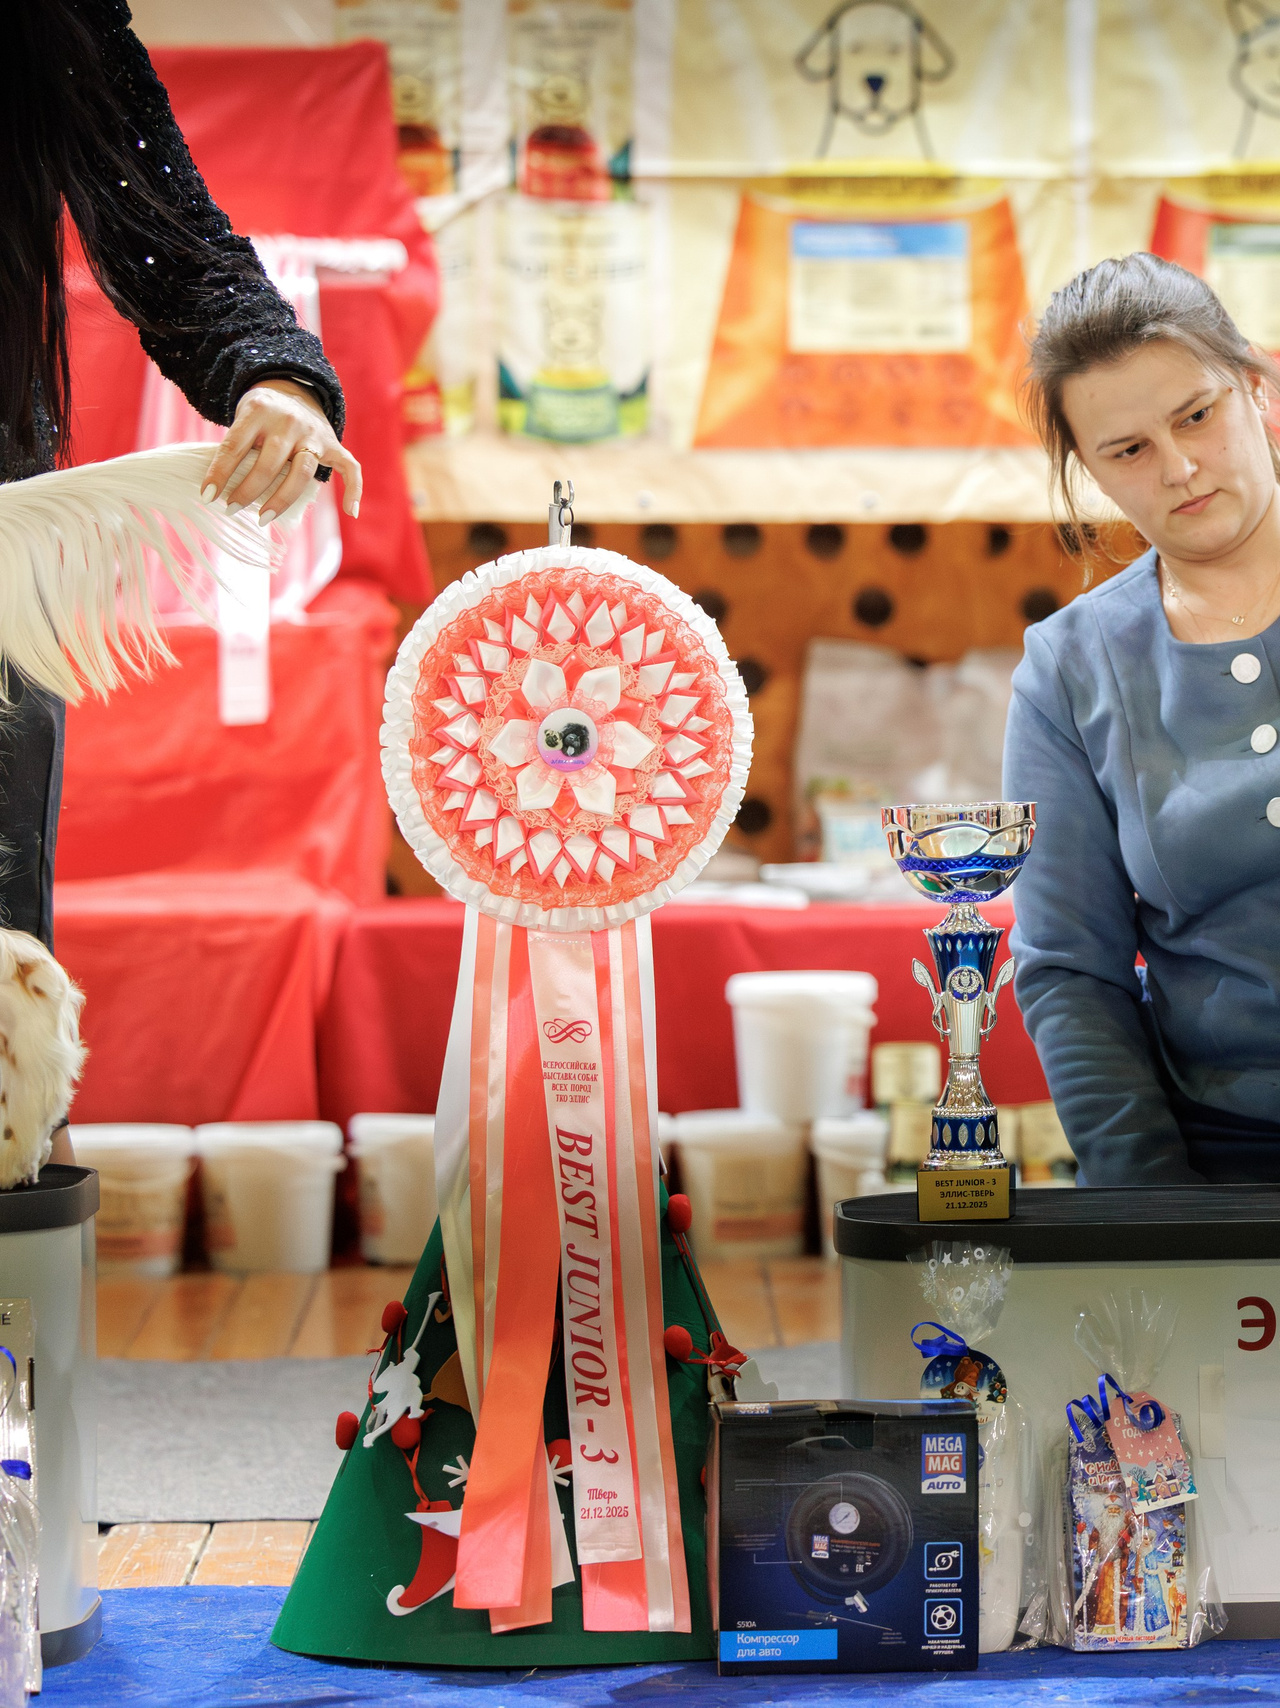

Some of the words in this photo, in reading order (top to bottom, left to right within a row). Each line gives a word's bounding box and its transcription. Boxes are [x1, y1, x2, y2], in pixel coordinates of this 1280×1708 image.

[542, 1060, 597, 1070] ВСЕРОССИЙСКАЯ
[543, 1071, 577, 1080] ВЫСТАВКА
[577, 1073, 599, 1081] СОБАК
[551, 1083, 568, 1091] ВСЕХ
[570, 1083, 592, 1093] ПОРОД
[555, 1094, 568, 1102] ТКО
[568, 1094, 591, 1103] ЭЛЛИС
[555, 1124, 600, 1240] BEST
[935, 1179, 954, 1187] BEST
[955, 1178, 985, 1187] JUNIOR
[991, 1178, 997, 1186] 3
[939, 1189, 995, 1198] ЭЛЛИС-ТВЕРЬ
[945, 1201, 988, 1210] 21.12.2025
[566, 1242, 611, 1408] JUNIOR
[925, 1436, 963, 1452] MEGA
[579, 1443, 620, 1465] 3
[928, 1455, 960, 1471] MAG
[926, 1480, 961, 1490] AUTO
[586, 1487, 618, 1505] Тверь
[580, 1505, 630, 1520] 21.12.2025
[736, 1620, 757, 1628] S510A
[736, 1633, 800, 1646] Компрессор
[736, 1649, 756, 1659] для
[758, 1648, 782, 1657] авто
